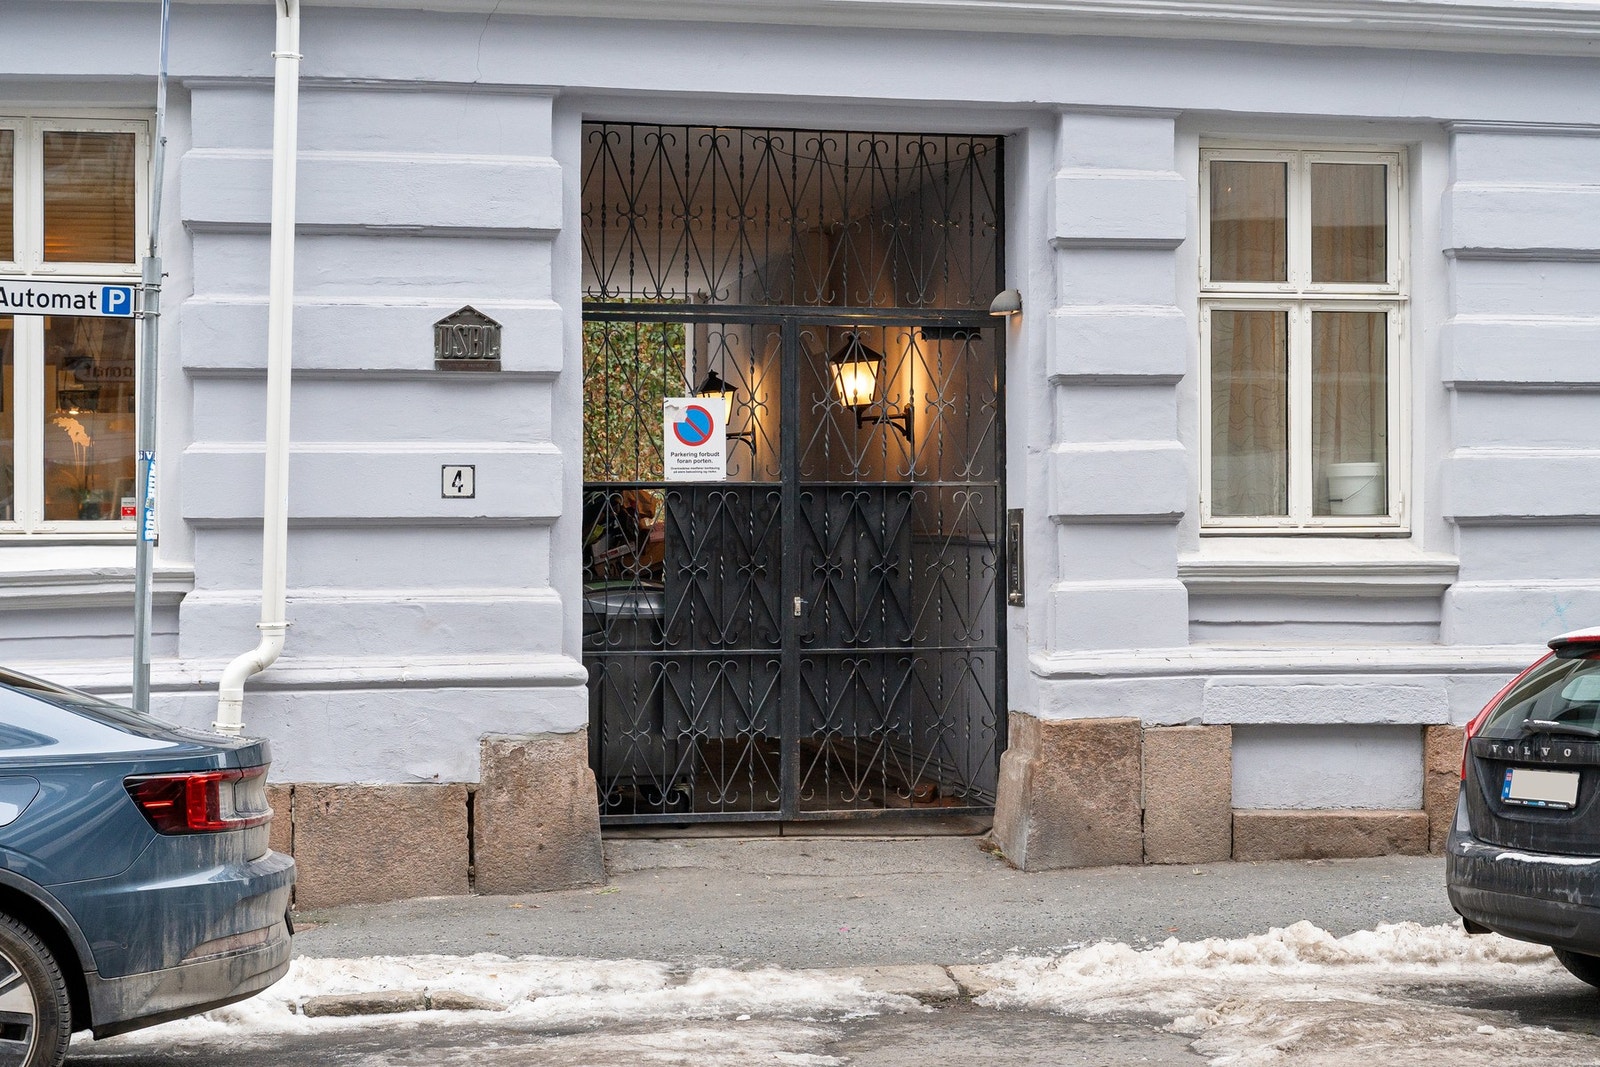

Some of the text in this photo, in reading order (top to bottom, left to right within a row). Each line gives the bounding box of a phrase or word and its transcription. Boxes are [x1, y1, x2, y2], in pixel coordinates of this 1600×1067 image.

[109, 289, 126, 312] P
[451, 470, 463, 493] 4
[1492, 744, 1572, 758] VOLVO
